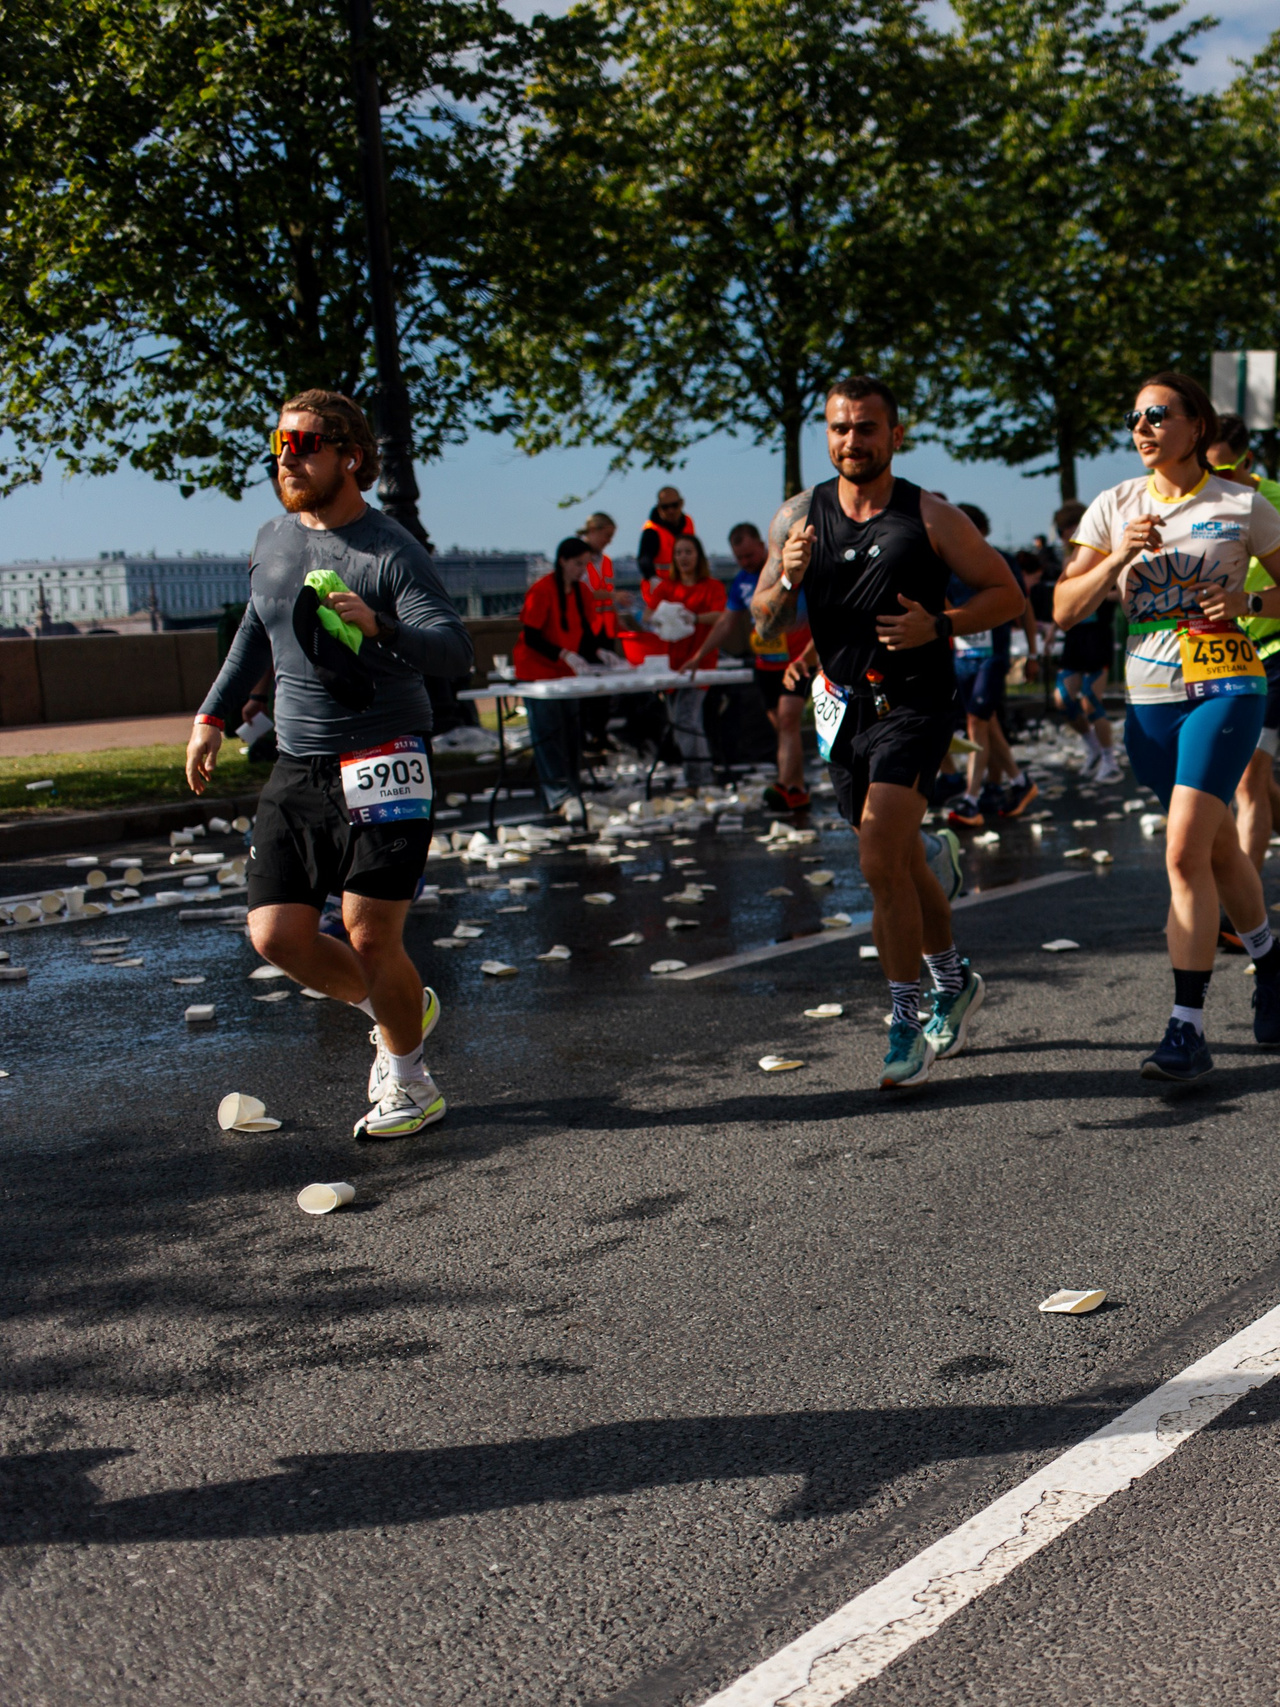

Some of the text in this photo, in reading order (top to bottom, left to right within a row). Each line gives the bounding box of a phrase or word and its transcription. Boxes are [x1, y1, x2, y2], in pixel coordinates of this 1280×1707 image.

[1191, 521, 1223, 531] NICE
[1193, 639, 1254, 665] 4590
[1206, 664, 1248, 675] SVETLANA
[1194, 683, 1205, 697] E
[356, 759, 425, 790] 5903
[380, 787, 411, 798] ПАВЕЛ
[359, 808, 371, 823] E
